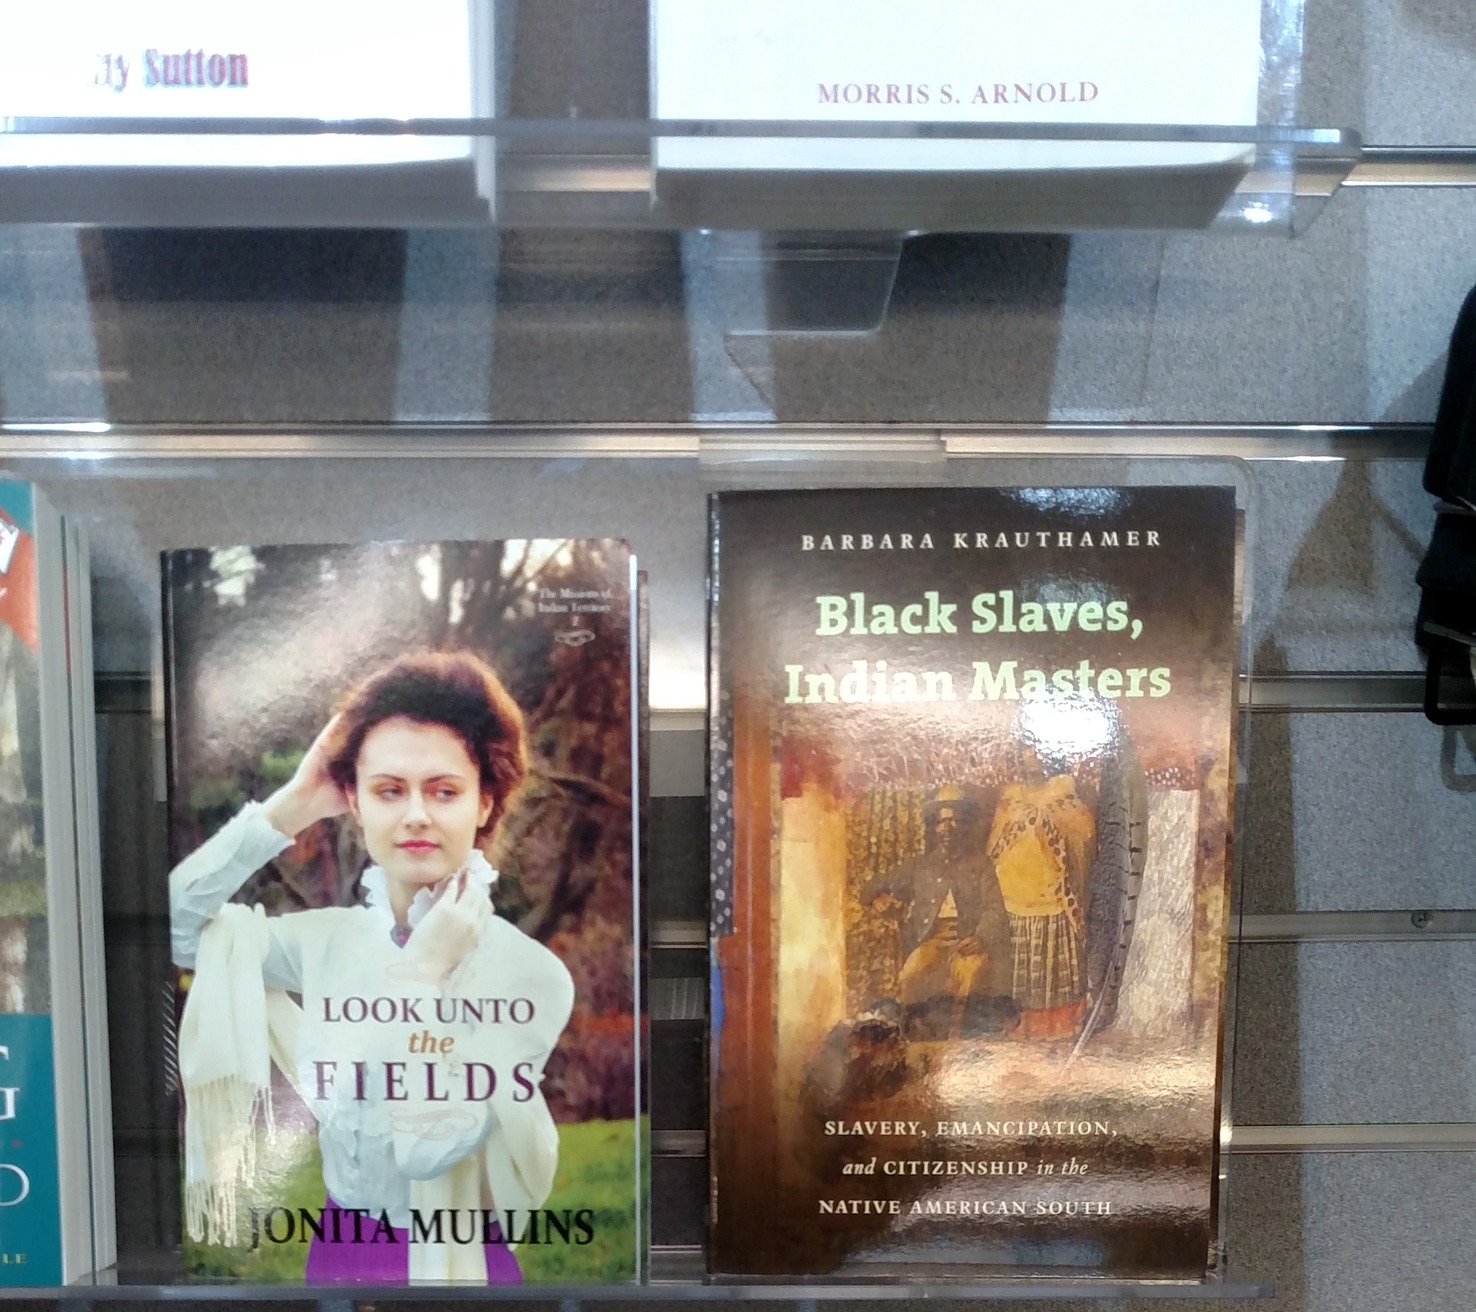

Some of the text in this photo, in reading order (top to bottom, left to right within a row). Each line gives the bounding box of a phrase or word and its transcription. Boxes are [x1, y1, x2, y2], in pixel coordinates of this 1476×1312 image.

[145, 48, 249, 88] Sutton
[817, 81, 1099, 105] MORRIS S. ARNOLD
[801, 530, 1162, 551] BARBARA KRAUTHAMER
[815, 589, 1144, 640] Black Slaves,
[784, 658, 1173, 705] Indian Masters
[322, 996, 536, 1024] LOOK UNTO
[407, 1030, 455, 1055] the
[312, 1060, 538, 1102] FIELDS
[824, 1120, 1118, 1139] SLAVERY, EMANCIPATION,
[842, 1156, 1089, 1176] and CITIZENSHIP in the
[818, 1199, 1112, 1216] NATIVE AMERICAN SOUTH
[248, 1207, 596, 1250] JONITA MULLINS
